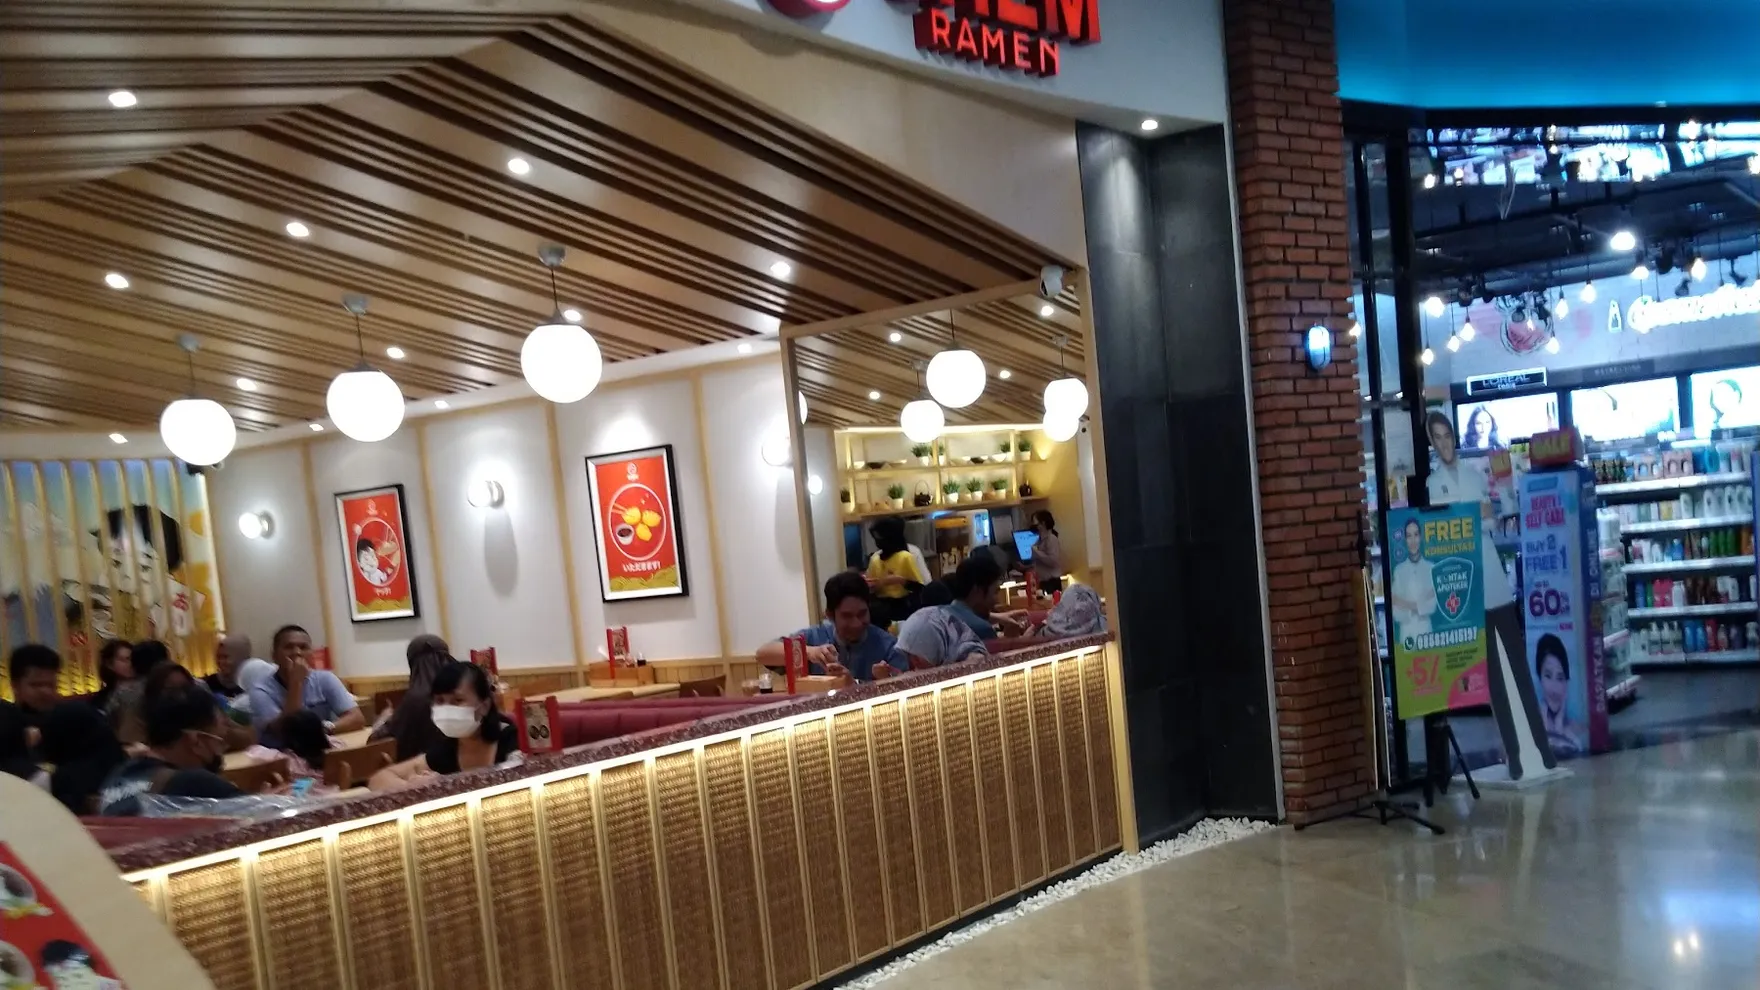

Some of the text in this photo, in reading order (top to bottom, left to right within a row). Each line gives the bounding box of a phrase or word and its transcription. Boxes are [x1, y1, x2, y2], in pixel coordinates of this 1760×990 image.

[930, 7, 1061, 76] RAMEN
[1424, 518, 1474, 542] FREE
[1526, 555, 1558, 572] FREE
[1588, 529, 1599, 576] ONLINE
[1529, 588, 1560, 617] 60
